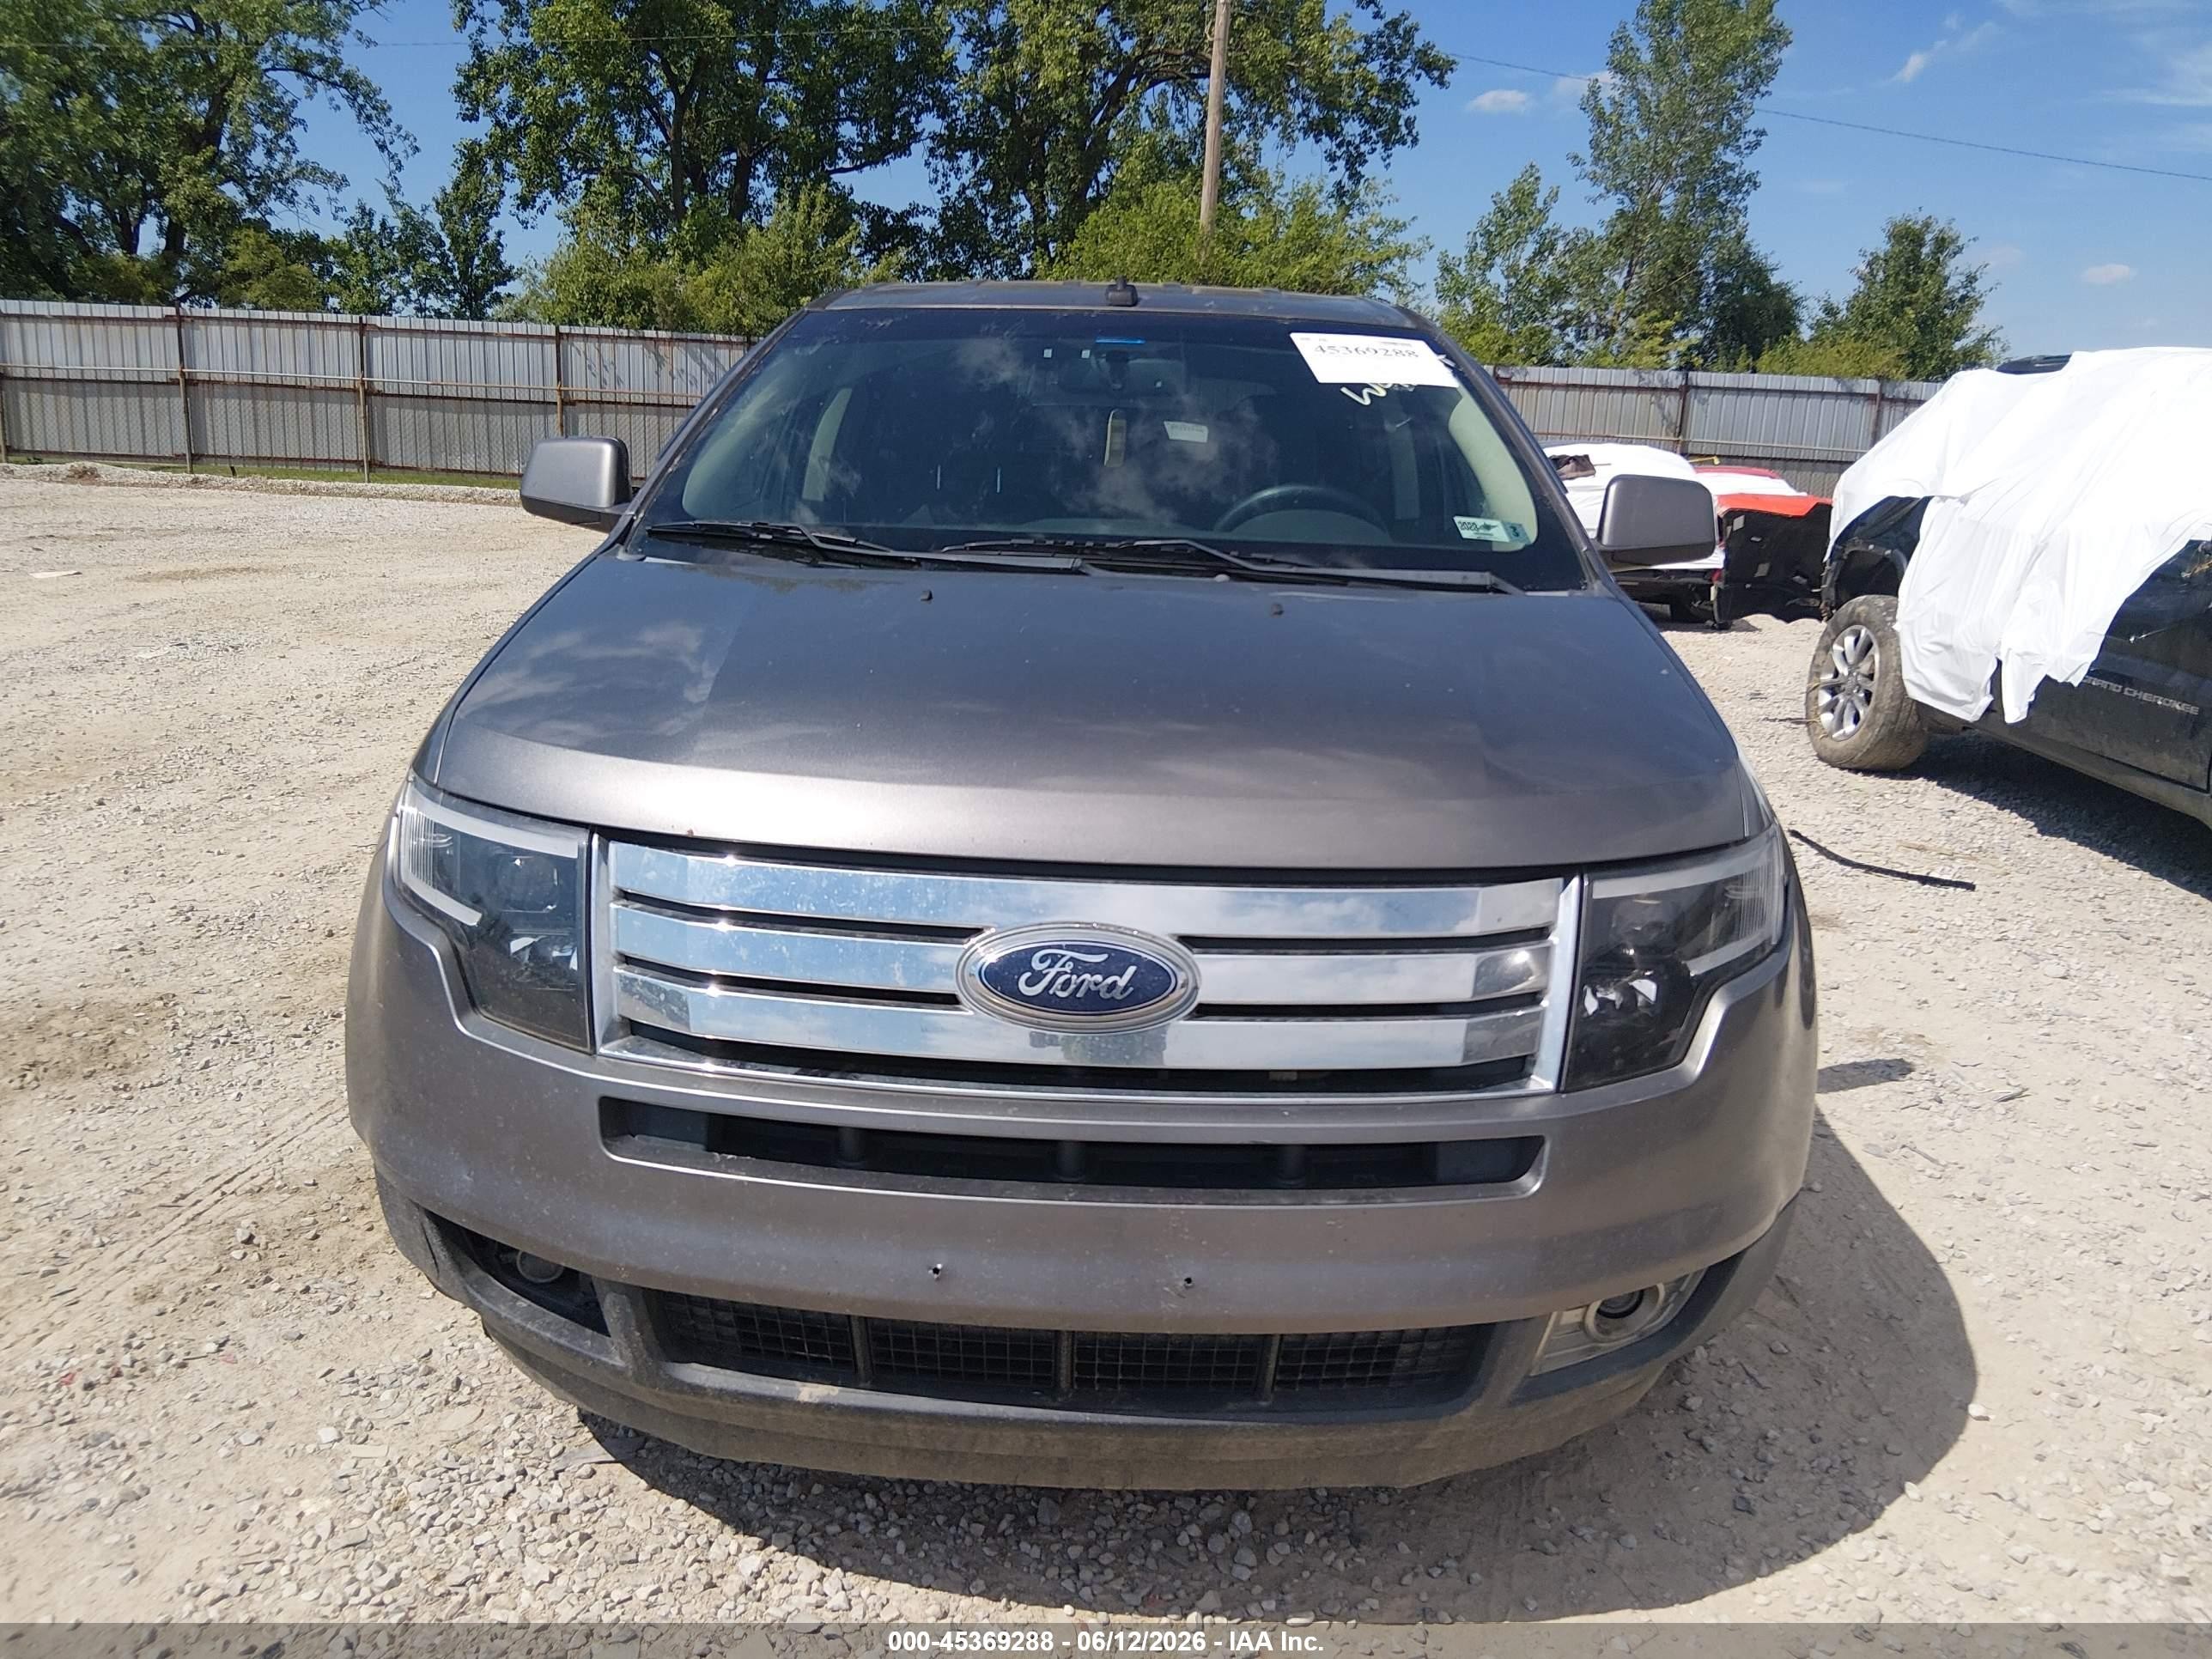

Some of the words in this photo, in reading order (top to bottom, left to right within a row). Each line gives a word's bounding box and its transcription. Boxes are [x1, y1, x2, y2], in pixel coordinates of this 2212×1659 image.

[1315, 344, 1419, 358] 45369288
[2124, 687, 2200, 714] CHEROKEE
[1018, 948, 1138, 1000] Ford
